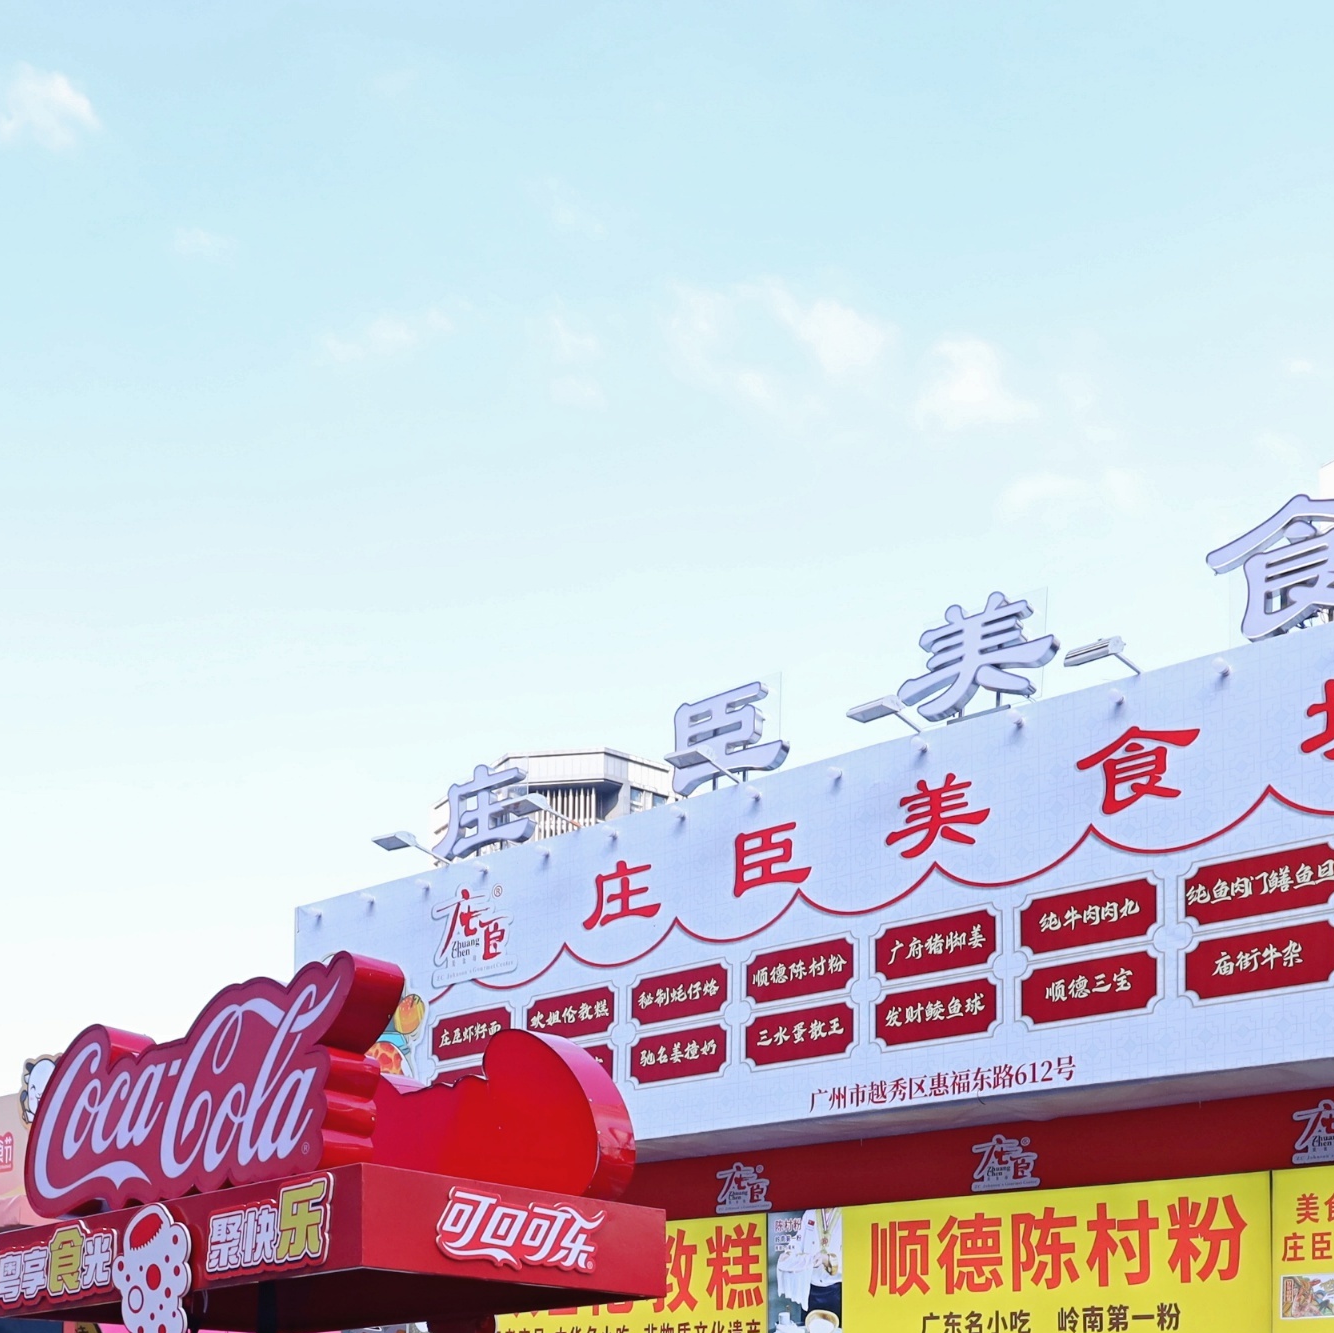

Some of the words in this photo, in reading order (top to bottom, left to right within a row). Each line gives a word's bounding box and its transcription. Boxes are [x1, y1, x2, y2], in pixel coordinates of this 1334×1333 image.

[1039, 897, 1141, 934] 纯牛肉肉丸
[451, 947, 471, 959] Chen
[452, 936, 480, 952] Zhuang
[887, 923, 987, 966] 广府猪脚姜
[1211, 939, 1304, 977] 庙街牛杂
[752, 954, 848, 988] 顺德陈村粉
[1045, 968, 1134, 1003] 顺德三宝
[637, 978, 720, 1010] 秘制蚝仔烙
[885, 992, 986, 1028] 发财鲮鱼球
[756, 1017, 845, 1047] 三水蛋散王
[639, 1039, 717, 1068] 驰名姜撞奶
[36, 980, 339, 1199] Coca-Cola
[809, 1055, 1077, 1114] 广州市越秀区惠福东路612号
[208, 1178, 329, 1271] 聚快乐
[440, 1188, 604, 1269] 可口可乐
[868, 1194, 1248, 1297] 顺德陈村粉
[1057, 1302, 1181, 1333] 岭南第一粉
